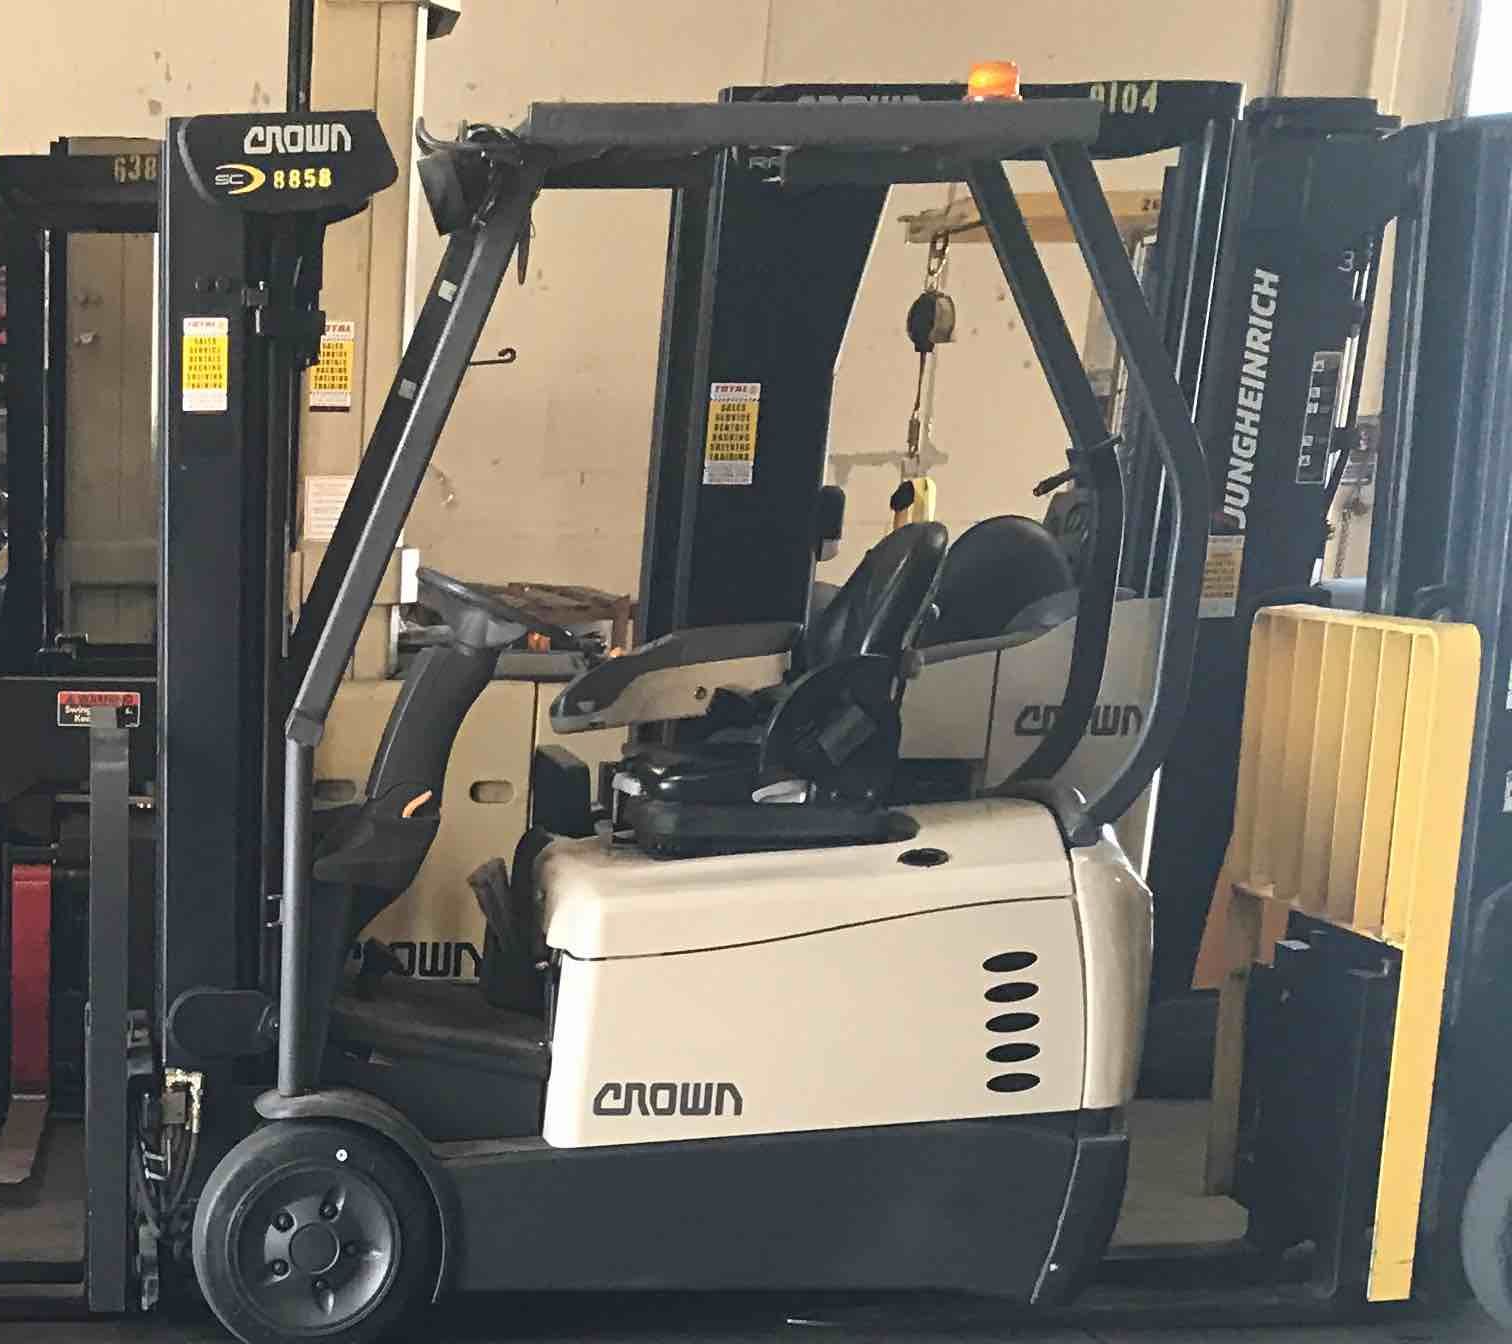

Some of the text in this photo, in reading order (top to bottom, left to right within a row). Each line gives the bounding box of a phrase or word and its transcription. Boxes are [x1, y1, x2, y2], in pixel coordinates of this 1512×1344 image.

[243, 124, 352, 155] CROWN
[215, 174, 244, 185] SC
[1223, 267, 1280, 530] JUNGHEINRICH
[1014, 705, 1144, 736] CRWN
[593, 1082, 743, 1116] CROWN
